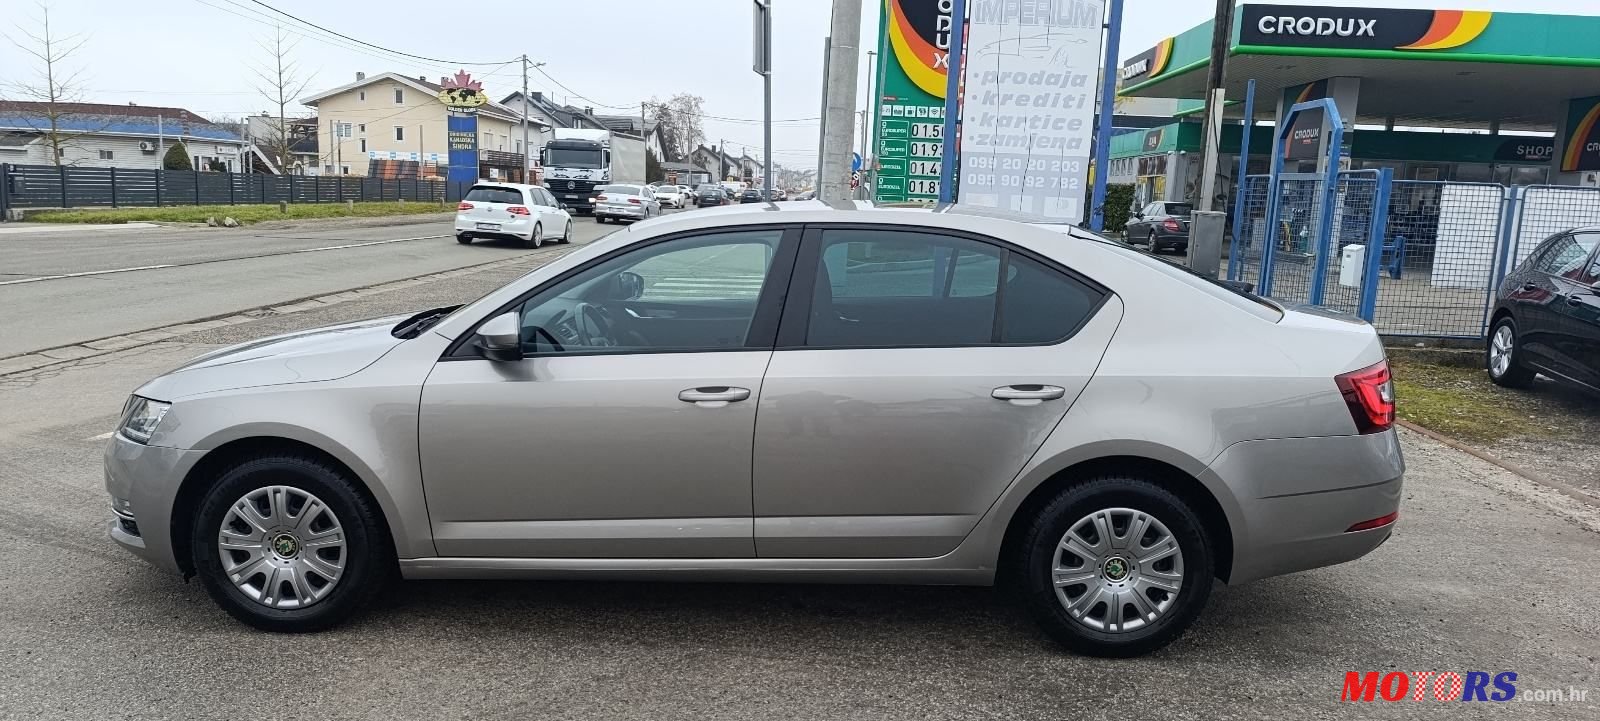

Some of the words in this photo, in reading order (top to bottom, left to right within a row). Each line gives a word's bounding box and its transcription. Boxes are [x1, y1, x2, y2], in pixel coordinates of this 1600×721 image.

[1258, 15, 1377, 37] CRODUX
[981, 70, 1088, 88] prodaja
[981, 90, 1087, 109] krediti
[979, 112, 1083, 131] kartice
[911, 124, 944, 138] 01.5
[1294, 128, 1319, 140] CRODUX
[910, 142, 943, 156] 01.9
[975, 133, 1083, 150] zamjena
[1516, 145, 1553, 156] SHOP
[910, 161, 942, 176] 01.4
[1002, 158, 1021, 170] 20
[1028, 159, 1046, 171] 20
[1050, 160, 1080, 173] 203
[908, 181, 940, 195] 01.8
[1001, 174, 1020, 187] 90
[1025, 176, 1045, 188] 92
[1050, 177, 1079, 190] 782
